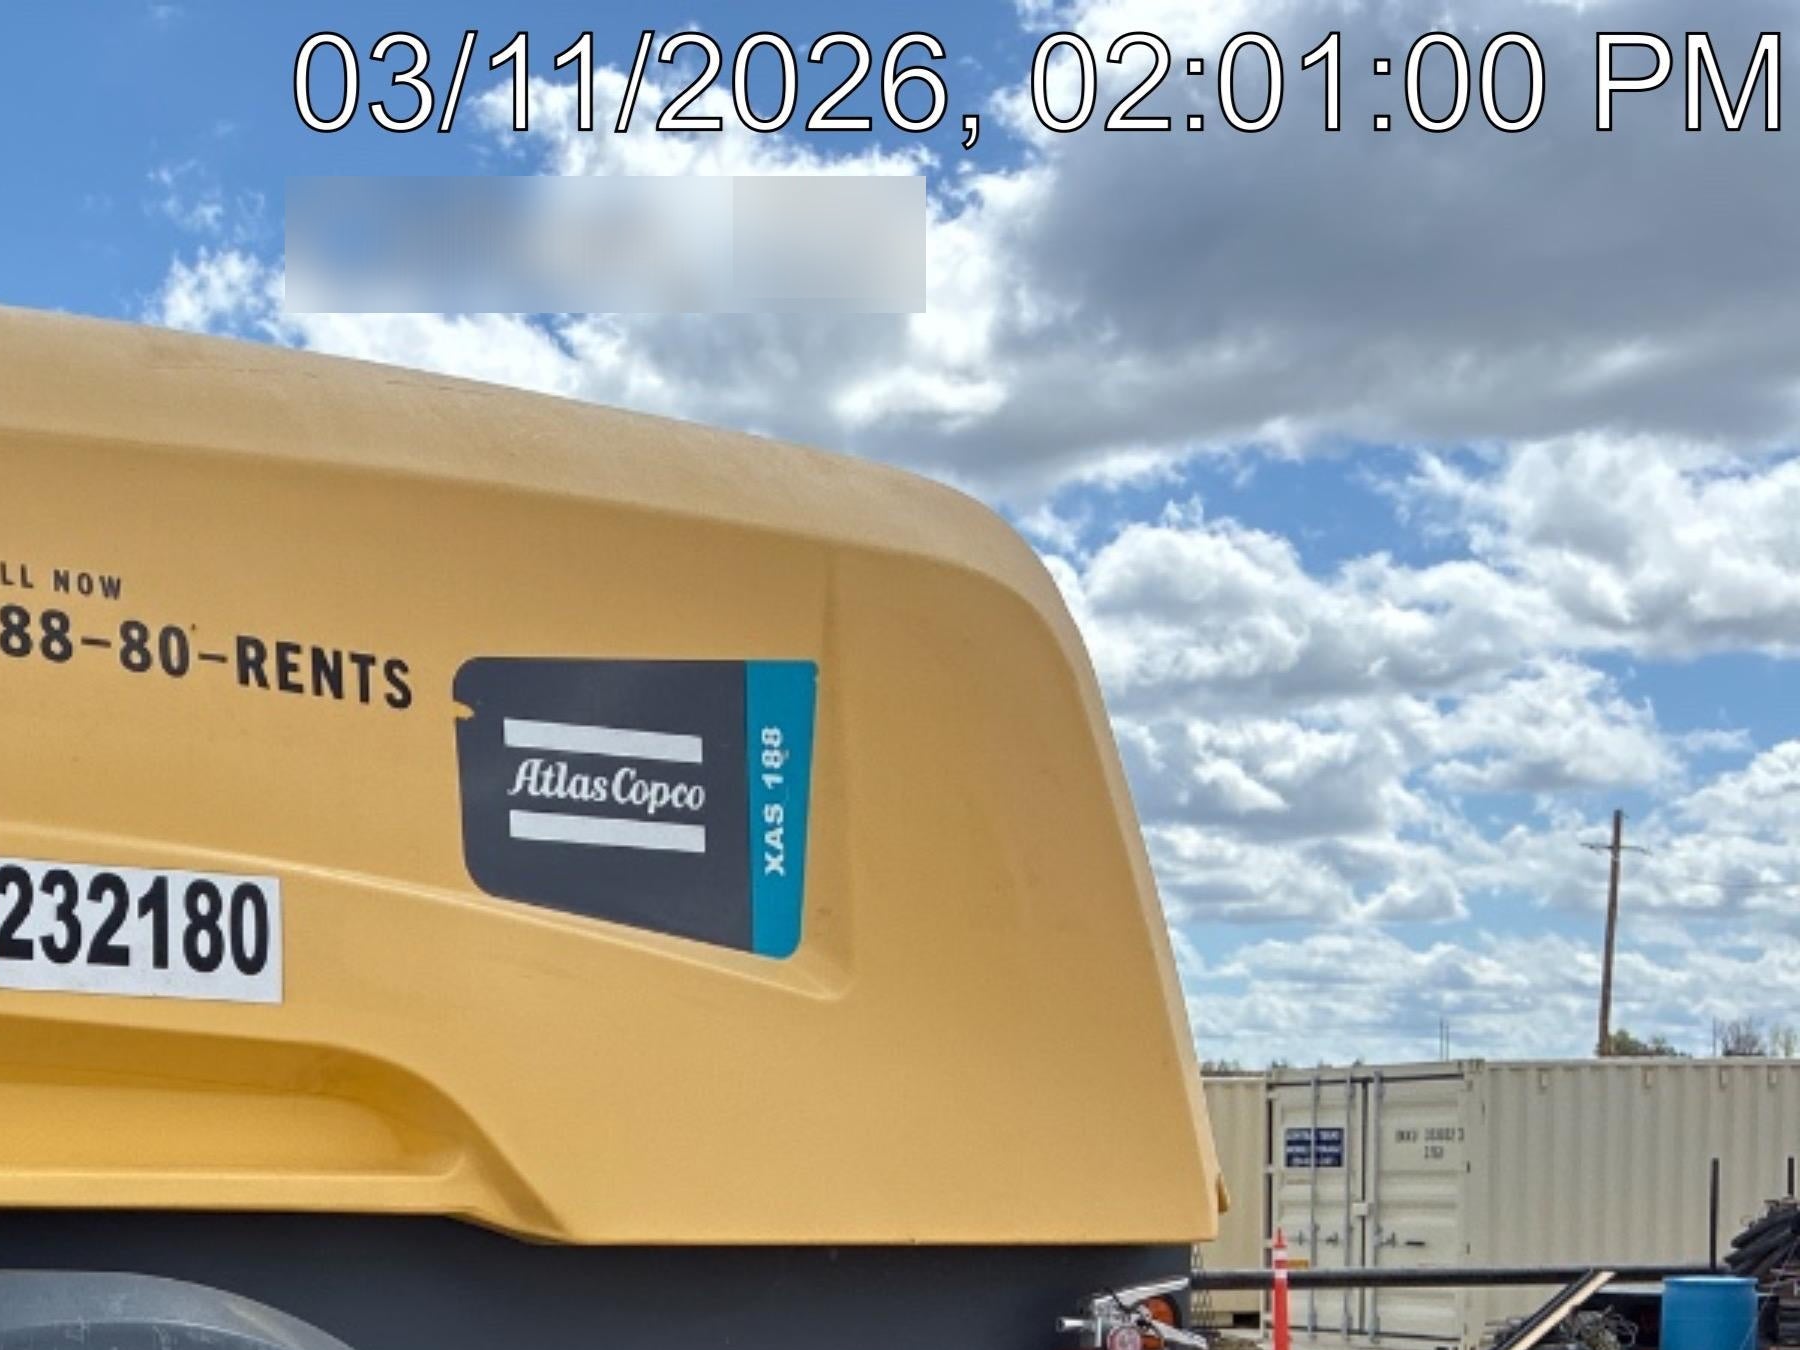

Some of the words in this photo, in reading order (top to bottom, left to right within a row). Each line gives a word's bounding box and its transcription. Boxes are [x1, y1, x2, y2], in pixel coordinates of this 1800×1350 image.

[53, 569, 122, 601] NOW
[760, 726, 784, 790] 188
[762, 804, 785, 876] XAS
